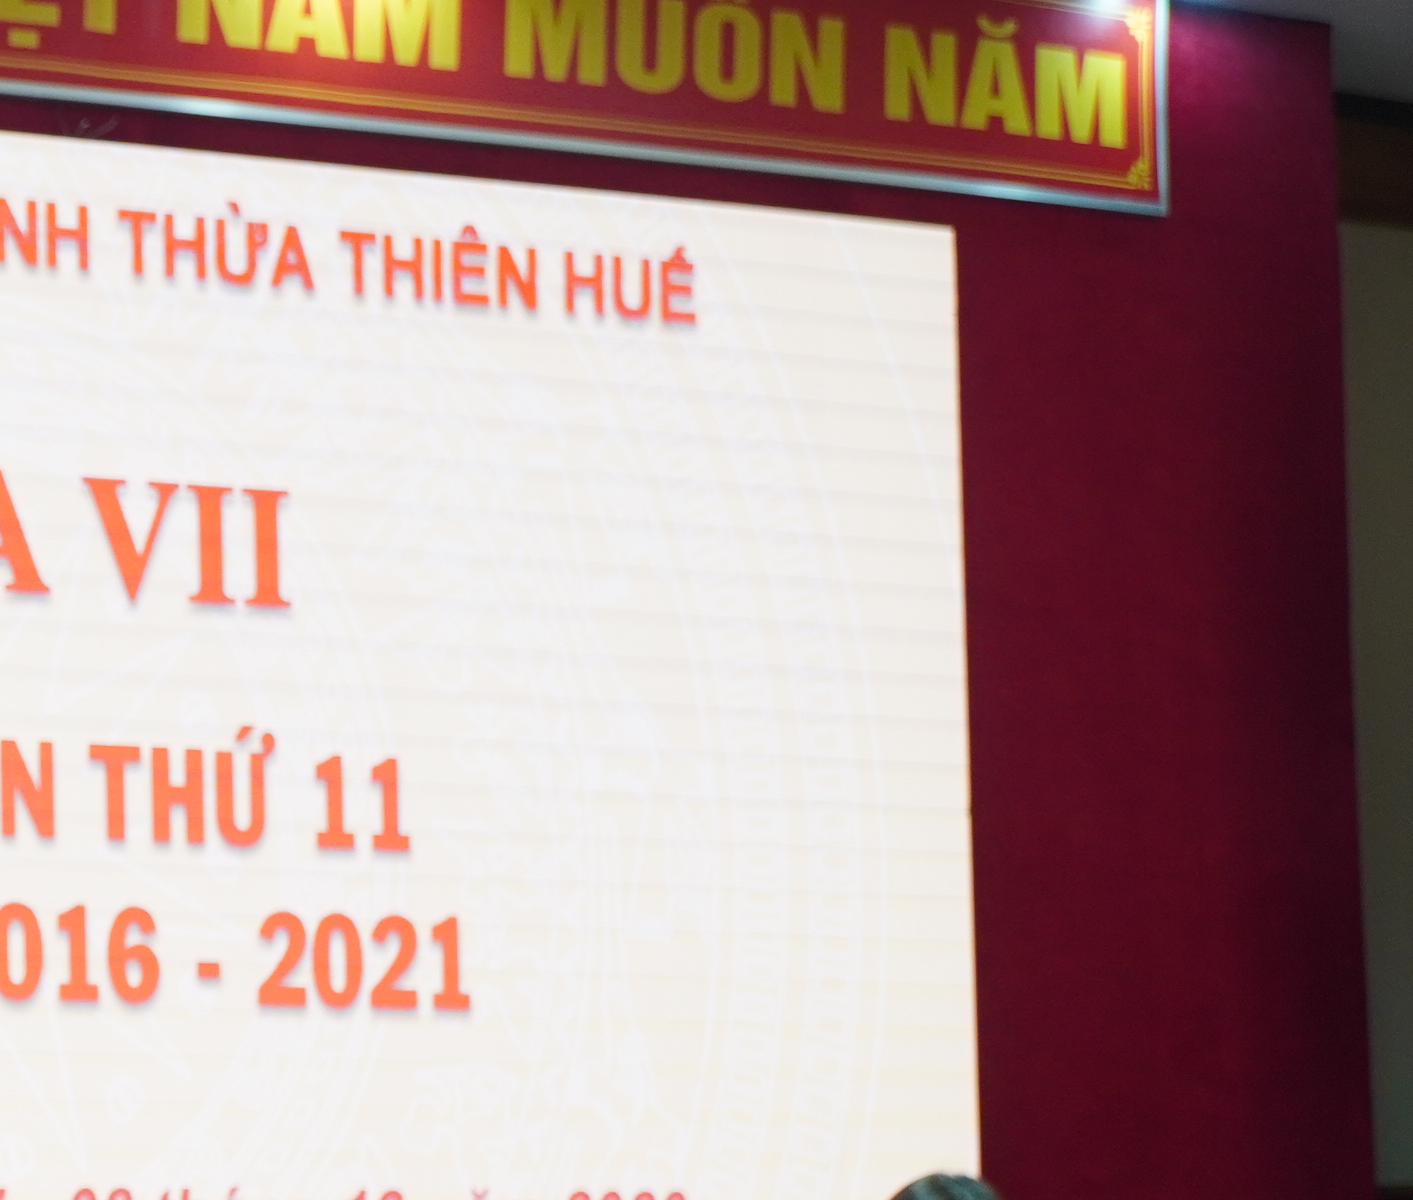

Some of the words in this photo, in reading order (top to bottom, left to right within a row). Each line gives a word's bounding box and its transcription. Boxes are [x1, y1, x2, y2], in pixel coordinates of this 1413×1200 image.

[884, 16, 1127, 149] NĂM
[117, 202, 314, 291] THỪA
[339, 225, 538, 311] THIÊN
[564, 246, 697, 324] HUẾ
[82, 476, 291, 609] VII
[88, 725, 276, 849] THỨ
[315, 754, 411, 853] 11
[197, 961, 222, 980] -
[258, 910, 472, 1011] 2021
